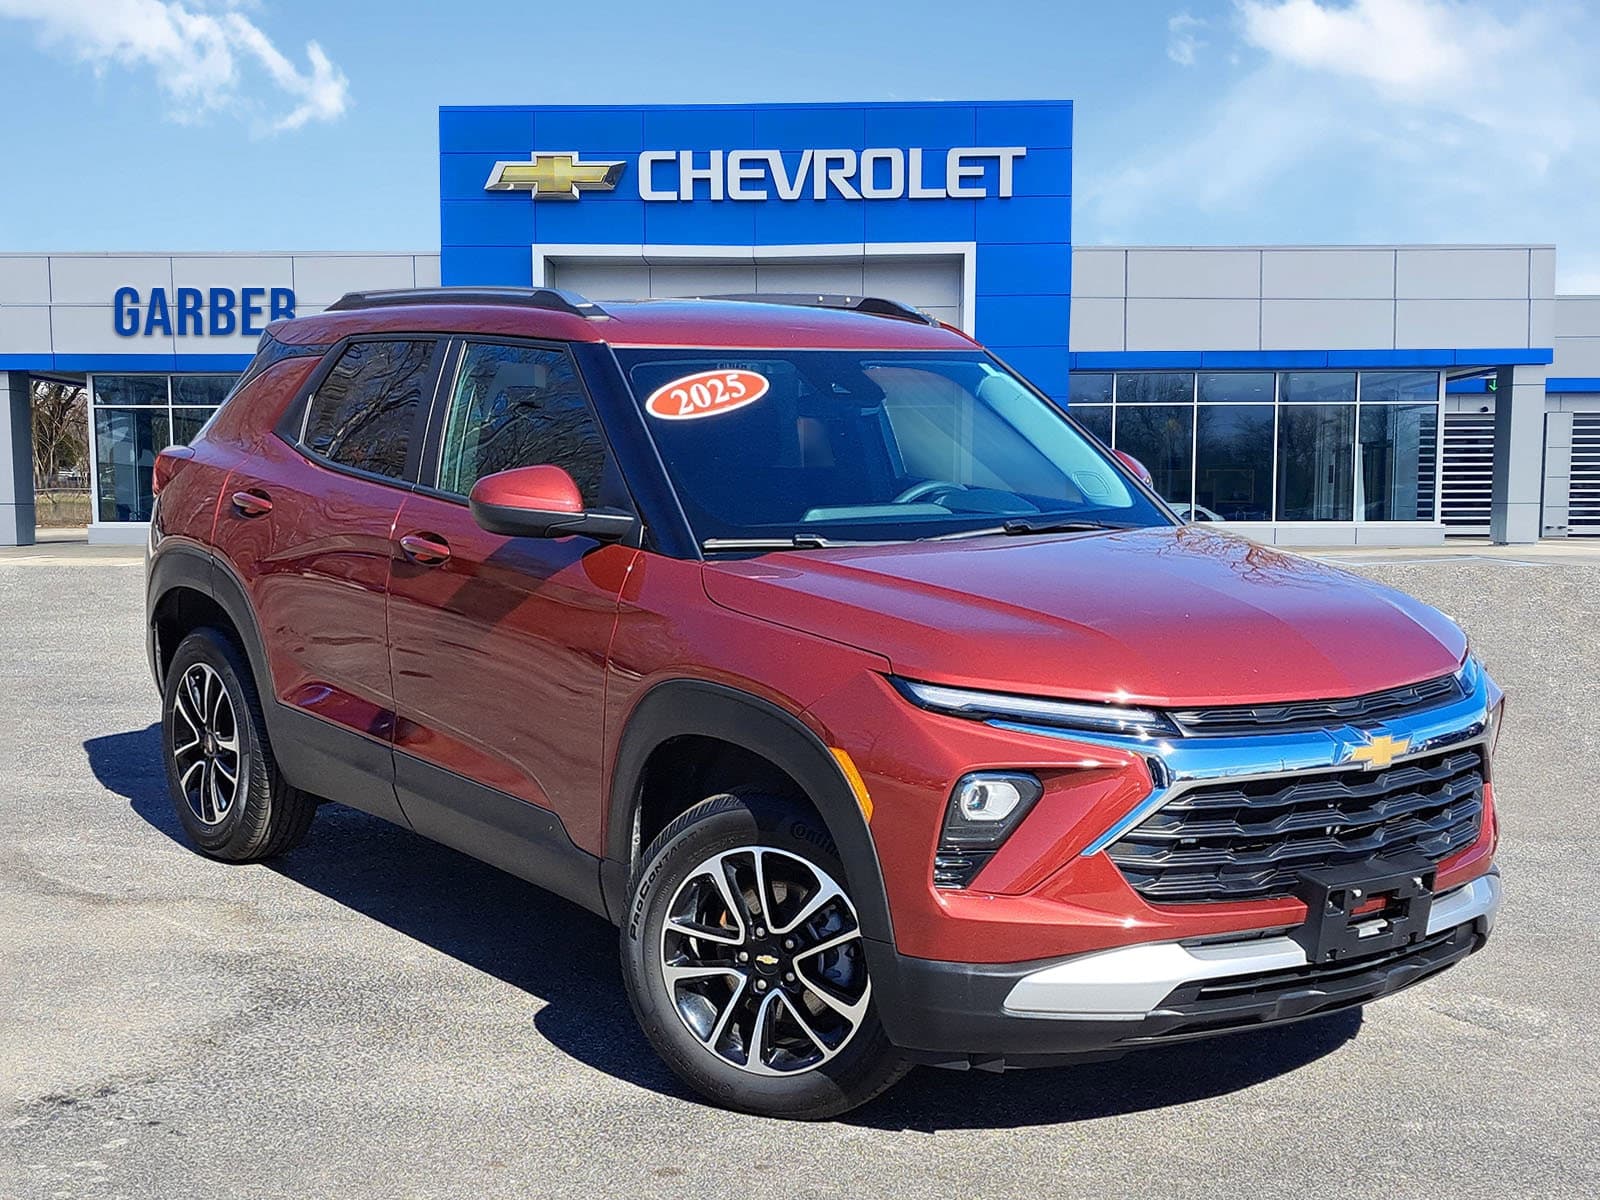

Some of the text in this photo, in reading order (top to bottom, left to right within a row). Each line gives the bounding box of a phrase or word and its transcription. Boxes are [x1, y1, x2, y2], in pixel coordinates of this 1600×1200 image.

[638, 146, 1027, 202] CHEVROLET
[114, 286, 296, 338] GARBER
[670, 374, 747, 416] 2025
